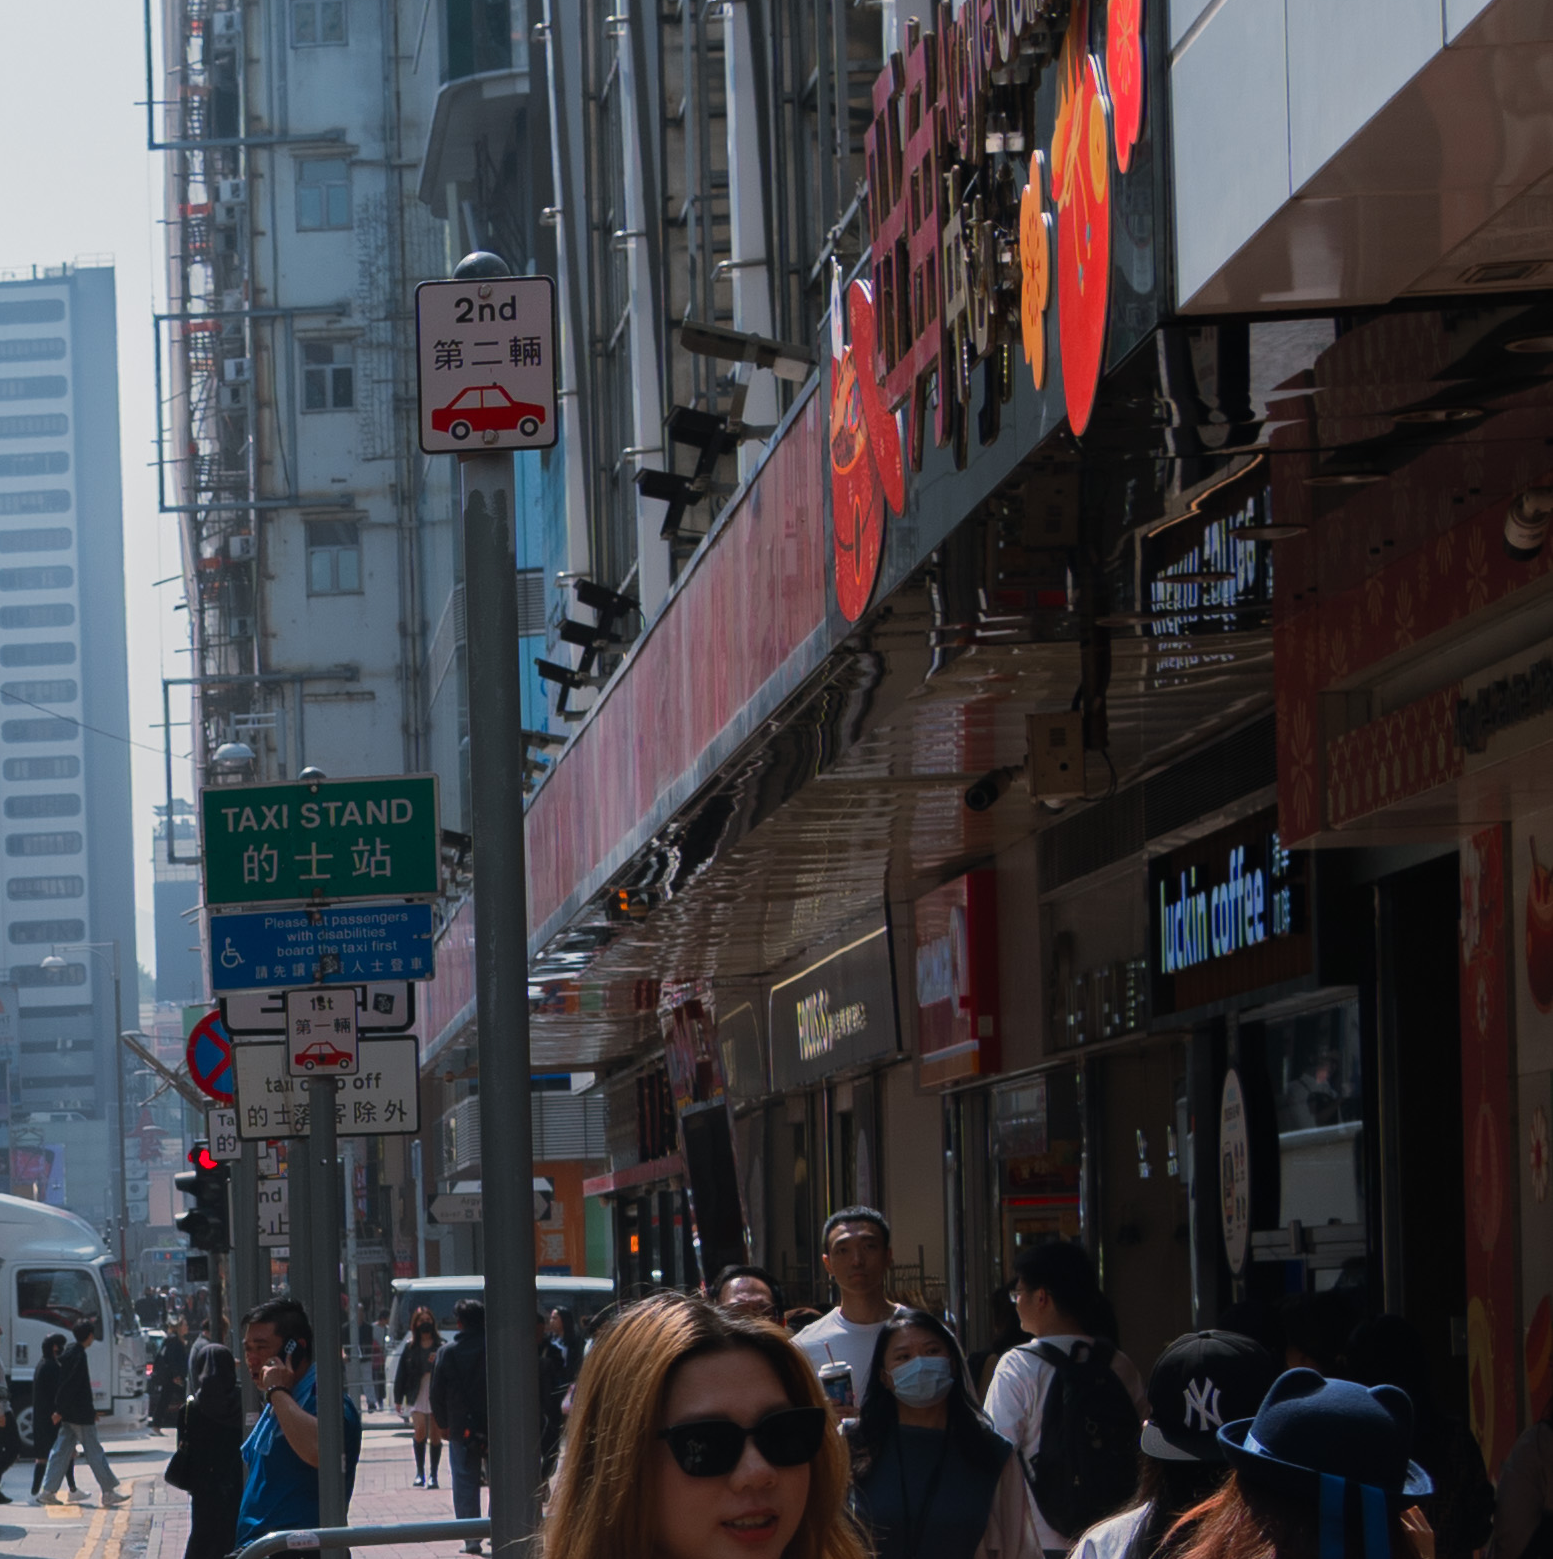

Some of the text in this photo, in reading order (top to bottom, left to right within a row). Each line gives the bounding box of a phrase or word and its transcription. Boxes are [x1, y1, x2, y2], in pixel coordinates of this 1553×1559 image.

[454, 295, 517, 323] 2nd
[433, 336, 542, 371] 第二輛
[220, 798, 414, 833] TAXI STAND
[242, 836, 392, 884] 的士站
[265, 915, 309, 930] Please
[331, 911, 409, 932] passengers
[1159, 844, 1265, 975] luckin coffee
[287, 928, 387, 943] with disabilities
[276, 940, 398, 957] board the taxi first
[310, 997, 334, 1011] 1st
[295, 1017, 352, 1036] 第一輛
[266, 1077, 294, 1094] taxi
[353, 1073, 383, 1090] off
[1182, 1377, 1224, 1431] NY
